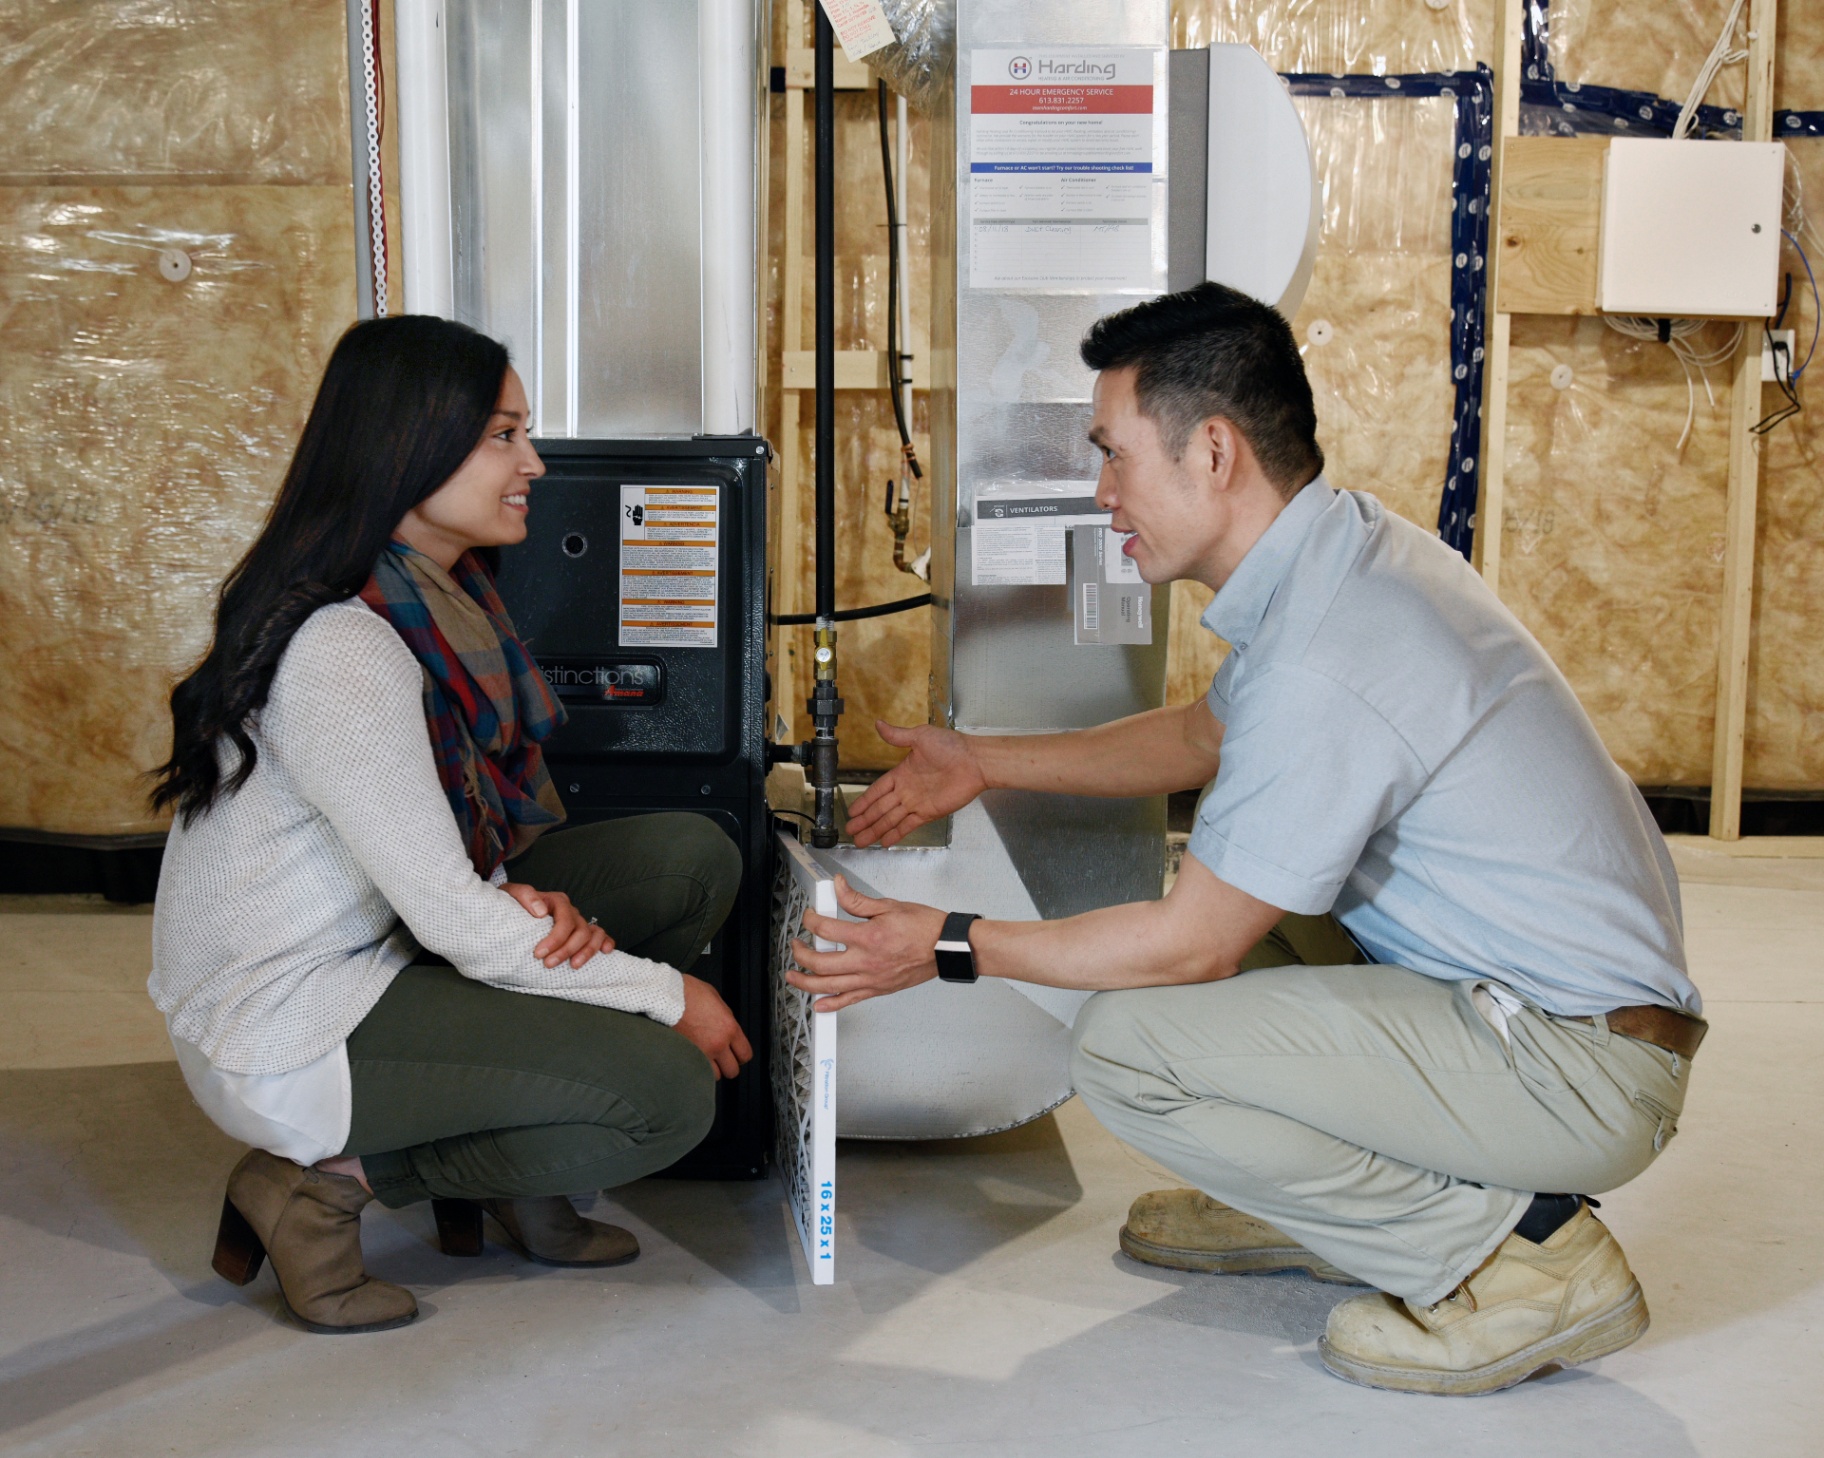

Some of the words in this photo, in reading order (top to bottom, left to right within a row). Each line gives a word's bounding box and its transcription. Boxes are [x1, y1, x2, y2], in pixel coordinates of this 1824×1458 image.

[1038, 59, 1116, 81] Harding
[1009, 88, 1018, 96] 24
[1020, 88, 1040, 96] HOUR
[1042, 88, 1085, 96] EMERGENCY
[1086, 88, 1114, 96] SERVICE
[1009, 505, 1058, 514] VENTILATORS
[541, 665, 644, 685] istinctions
[604, 684, 644, 697] Amana
[820, 1181, 832, 1200] 16
[820, 1203, 830, 1212] x
[820, 1216, 832, 1235] 25
[820, 1239, 829, 1248] x
[820, 1252, 831, 1260] 1
